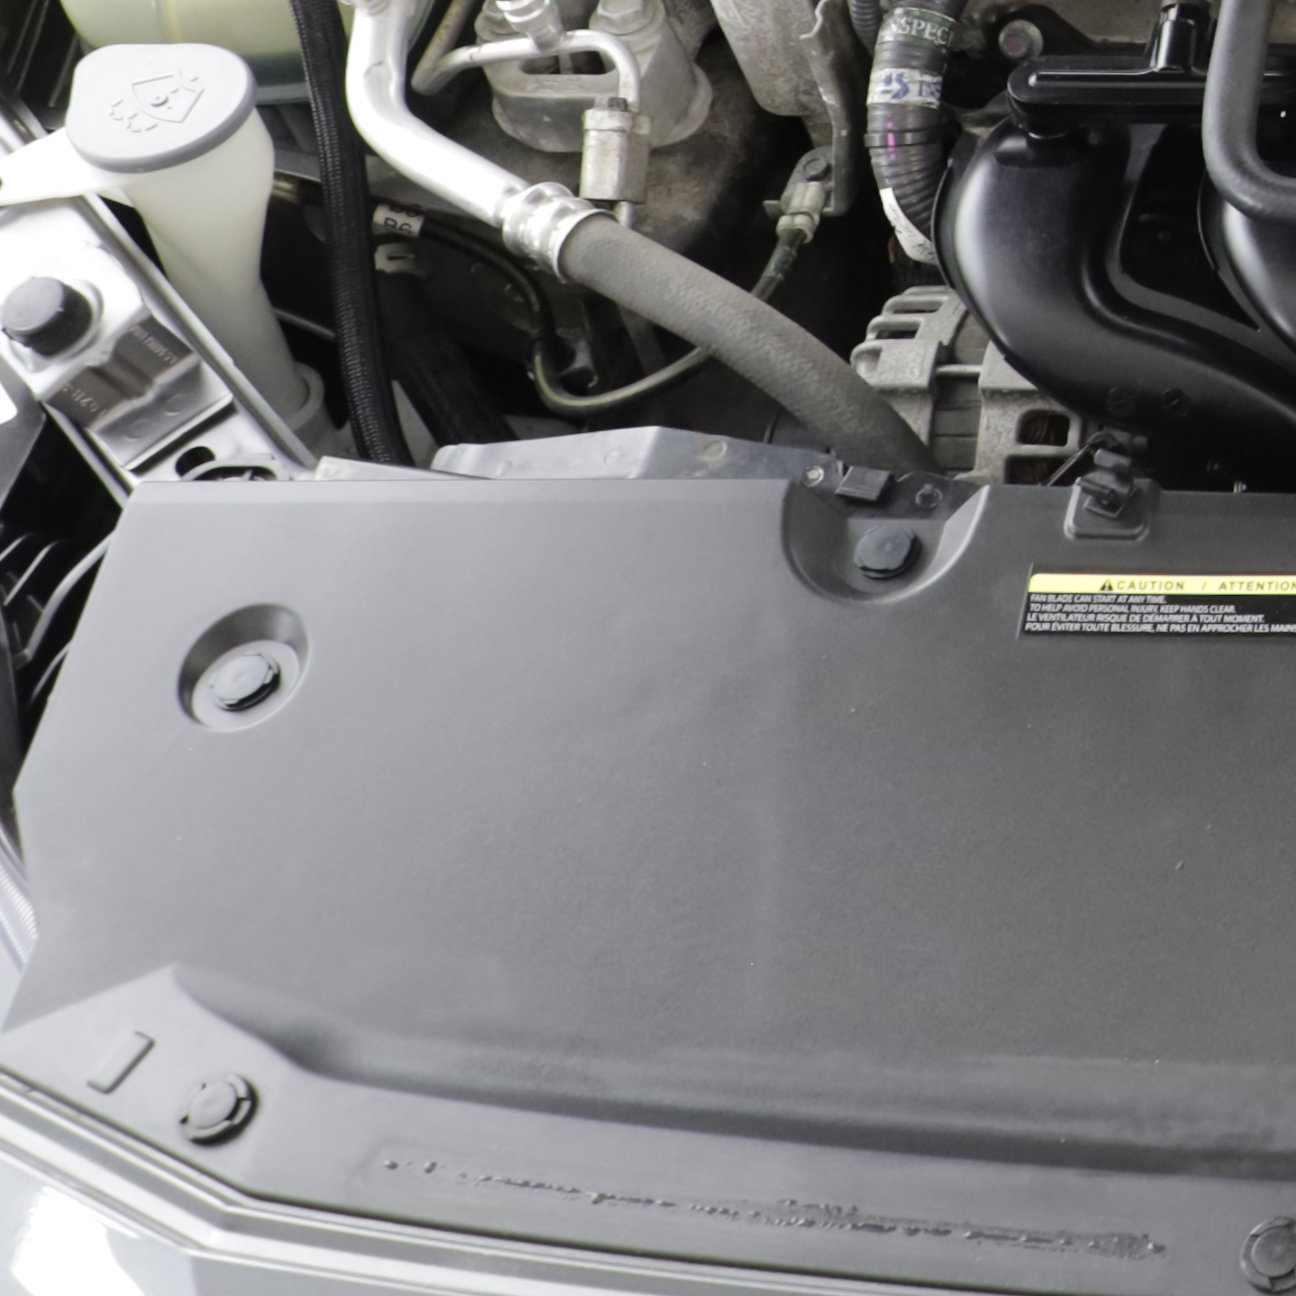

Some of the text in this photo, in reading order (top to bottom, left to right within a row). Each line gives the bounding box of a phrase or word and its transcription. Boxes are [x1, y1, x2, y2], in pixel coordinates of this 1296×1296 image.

[1117, 581, 1185, 591] CAUTION
[1030, 594, 1166, 603] FAN BLADE CAN START AT ANY TIME.
[1030, 604, 1041, 613] TO
[1042, 604, 1062, 613] HELP
[1063, 604, 1088, 613] AVOID
[1089, 604, 1129, 613] PERSONAL
[1160, 604, 1179, 613] KEEP
[1180, 604, 1208, 613] HANDS
[1210, 604, 1235, 613] CLEAR.
[1027, 613, 1038, 623] LE
[1039, 613, 1095, 623] VENTILATEUR
[1097, 613, 1125, 623] RISQUE
[1129, 613, 1141, 623] DE
[1199, 613, 1223, 623] TOUT
[1224, 613, 1264, 623] MOMENT.
[1025, 623, 1050, 632] POUR
[1082, 623, 1109, 632] TOUTE
[1157, 623, 1168, 632] NE
[1170, 623, 1186, 632] PAS
[1187, 623, 1200, 632] EN
[1201, 623, 1253, 632] APPROCHER
[1254, 623, 1269, 632] LES
